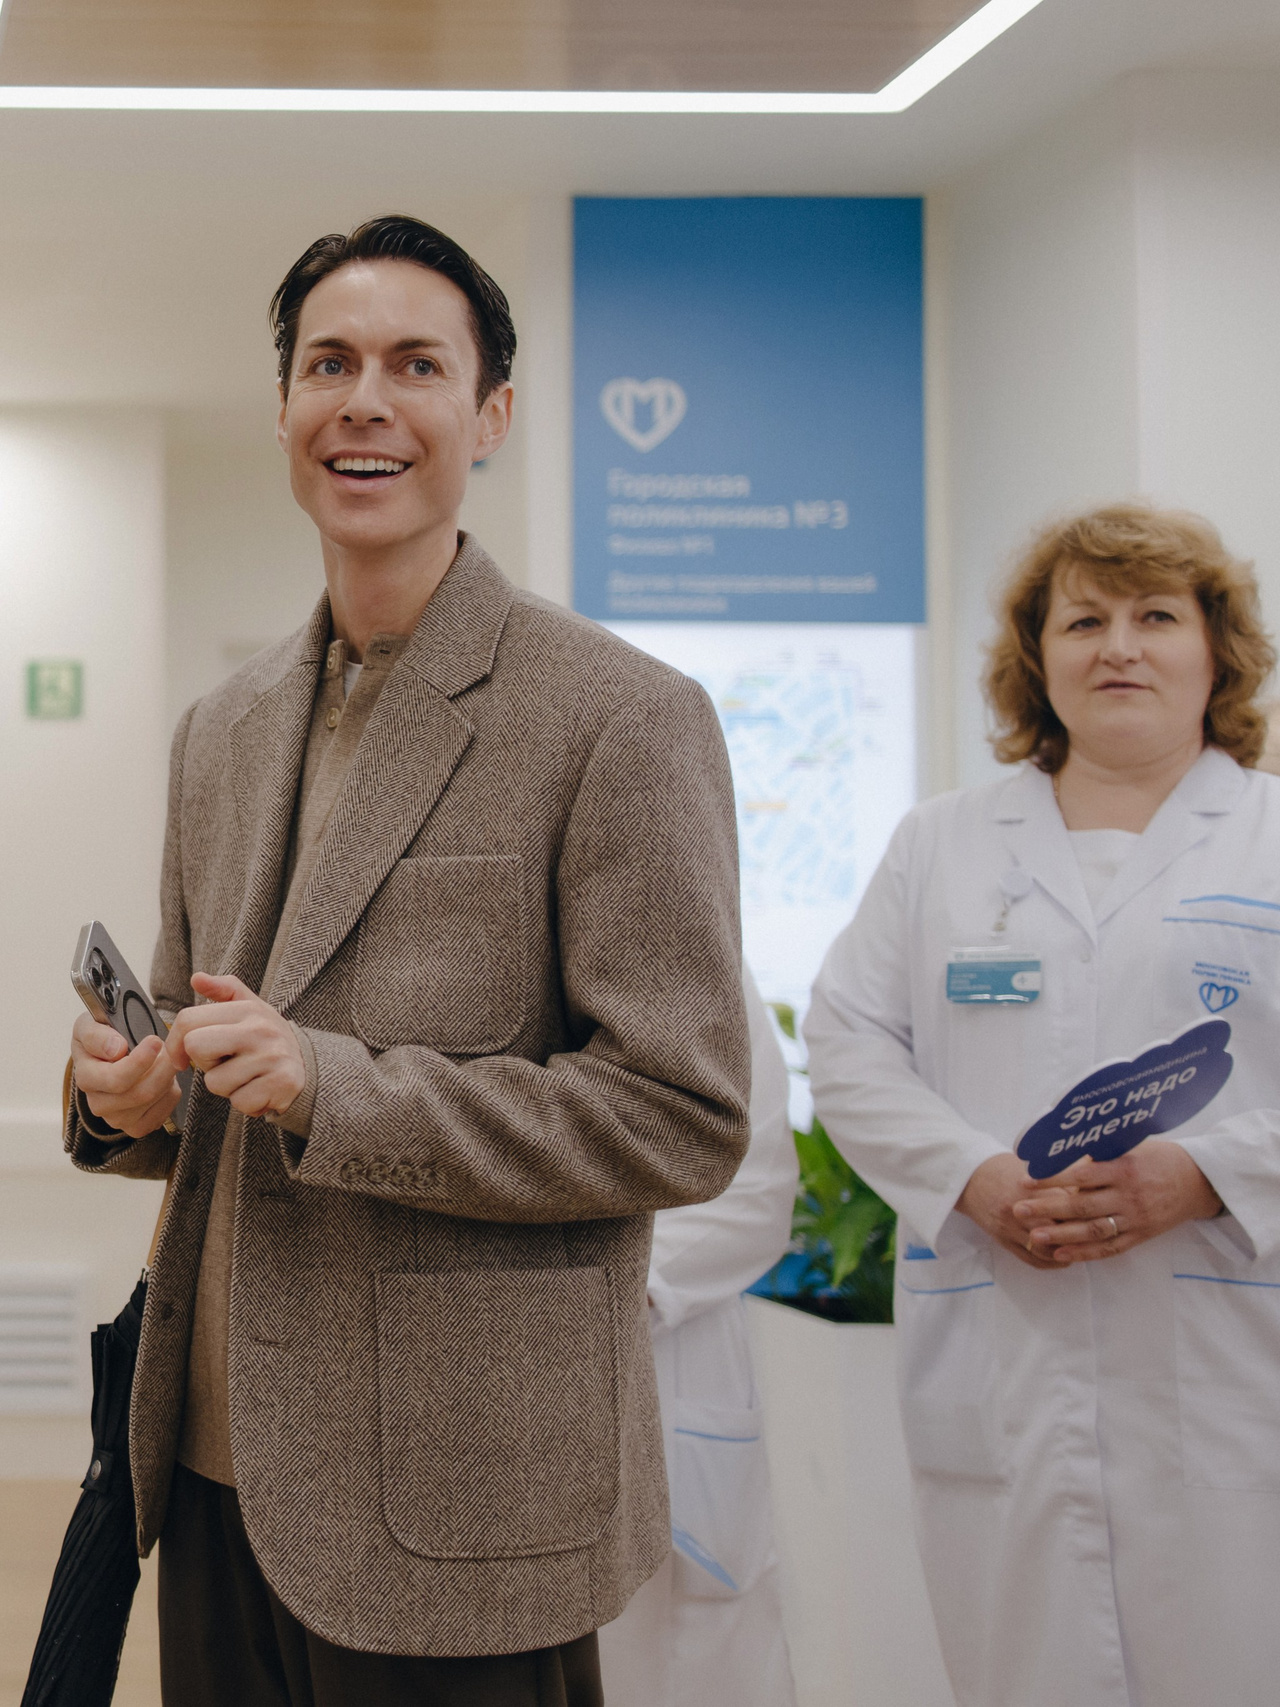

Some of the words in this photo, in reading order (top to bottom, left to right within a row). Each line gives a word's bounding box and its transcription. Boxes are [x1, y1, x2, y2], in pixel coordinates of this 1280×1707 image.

[1048, 1097, 1161, 1157] видеть!
[1060, 1098, 1118, 1130] Это
[1125, 1066, 1198, 1107] надо
